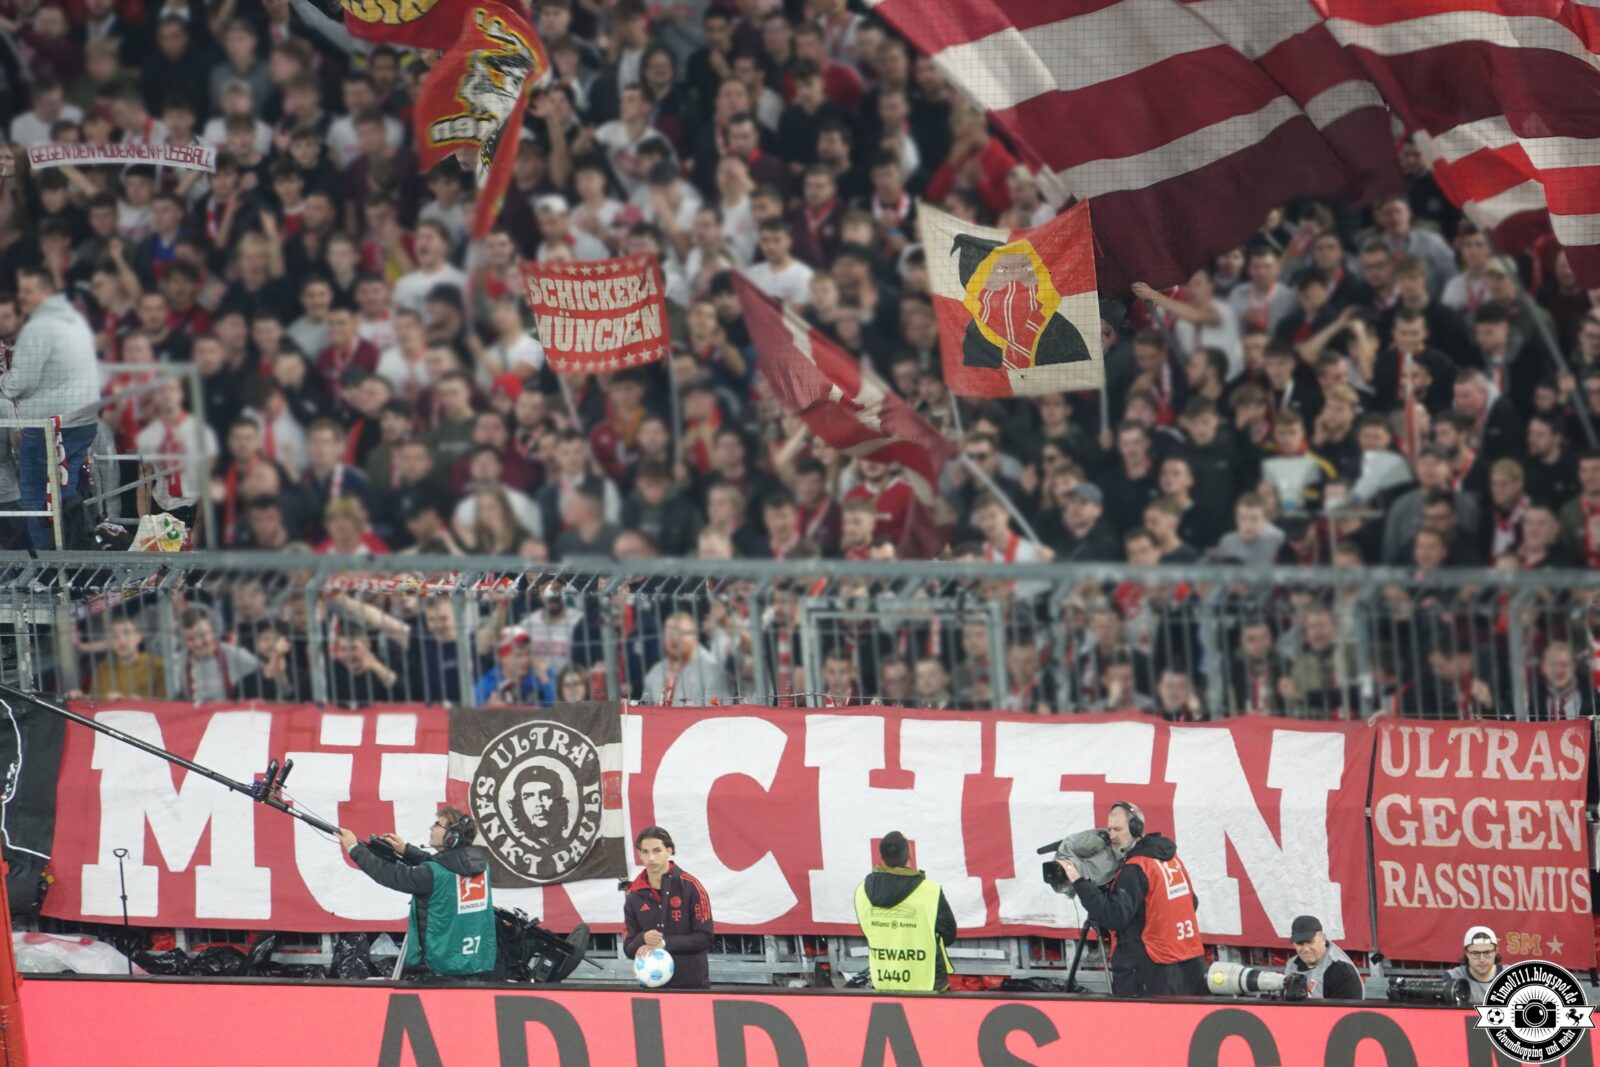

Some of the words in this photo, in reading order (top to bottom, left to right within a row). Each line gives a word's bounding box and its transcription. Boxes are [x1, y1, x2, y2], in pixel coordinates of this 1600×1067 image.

[31, 145, 71, 164] GEGEN
[73, 144, 96, 159] DEN
[1380, 724, 1586, 782] ULTRAS
[476, 775, 542, 875] SANKT
[552, 782, 600, 874] PAULI
[1375, 793, 1584, 852] GEGEN
[1379, 860, 1592, 914] RASSISMUS
[1176, 919, 1194, 941] 33
[462, 936, 481, 955] 27
[870, 947, 926, 962] TEWARD
[1505, 931, 1543, 956] SM
[877, 969, 911, 983] 1440
